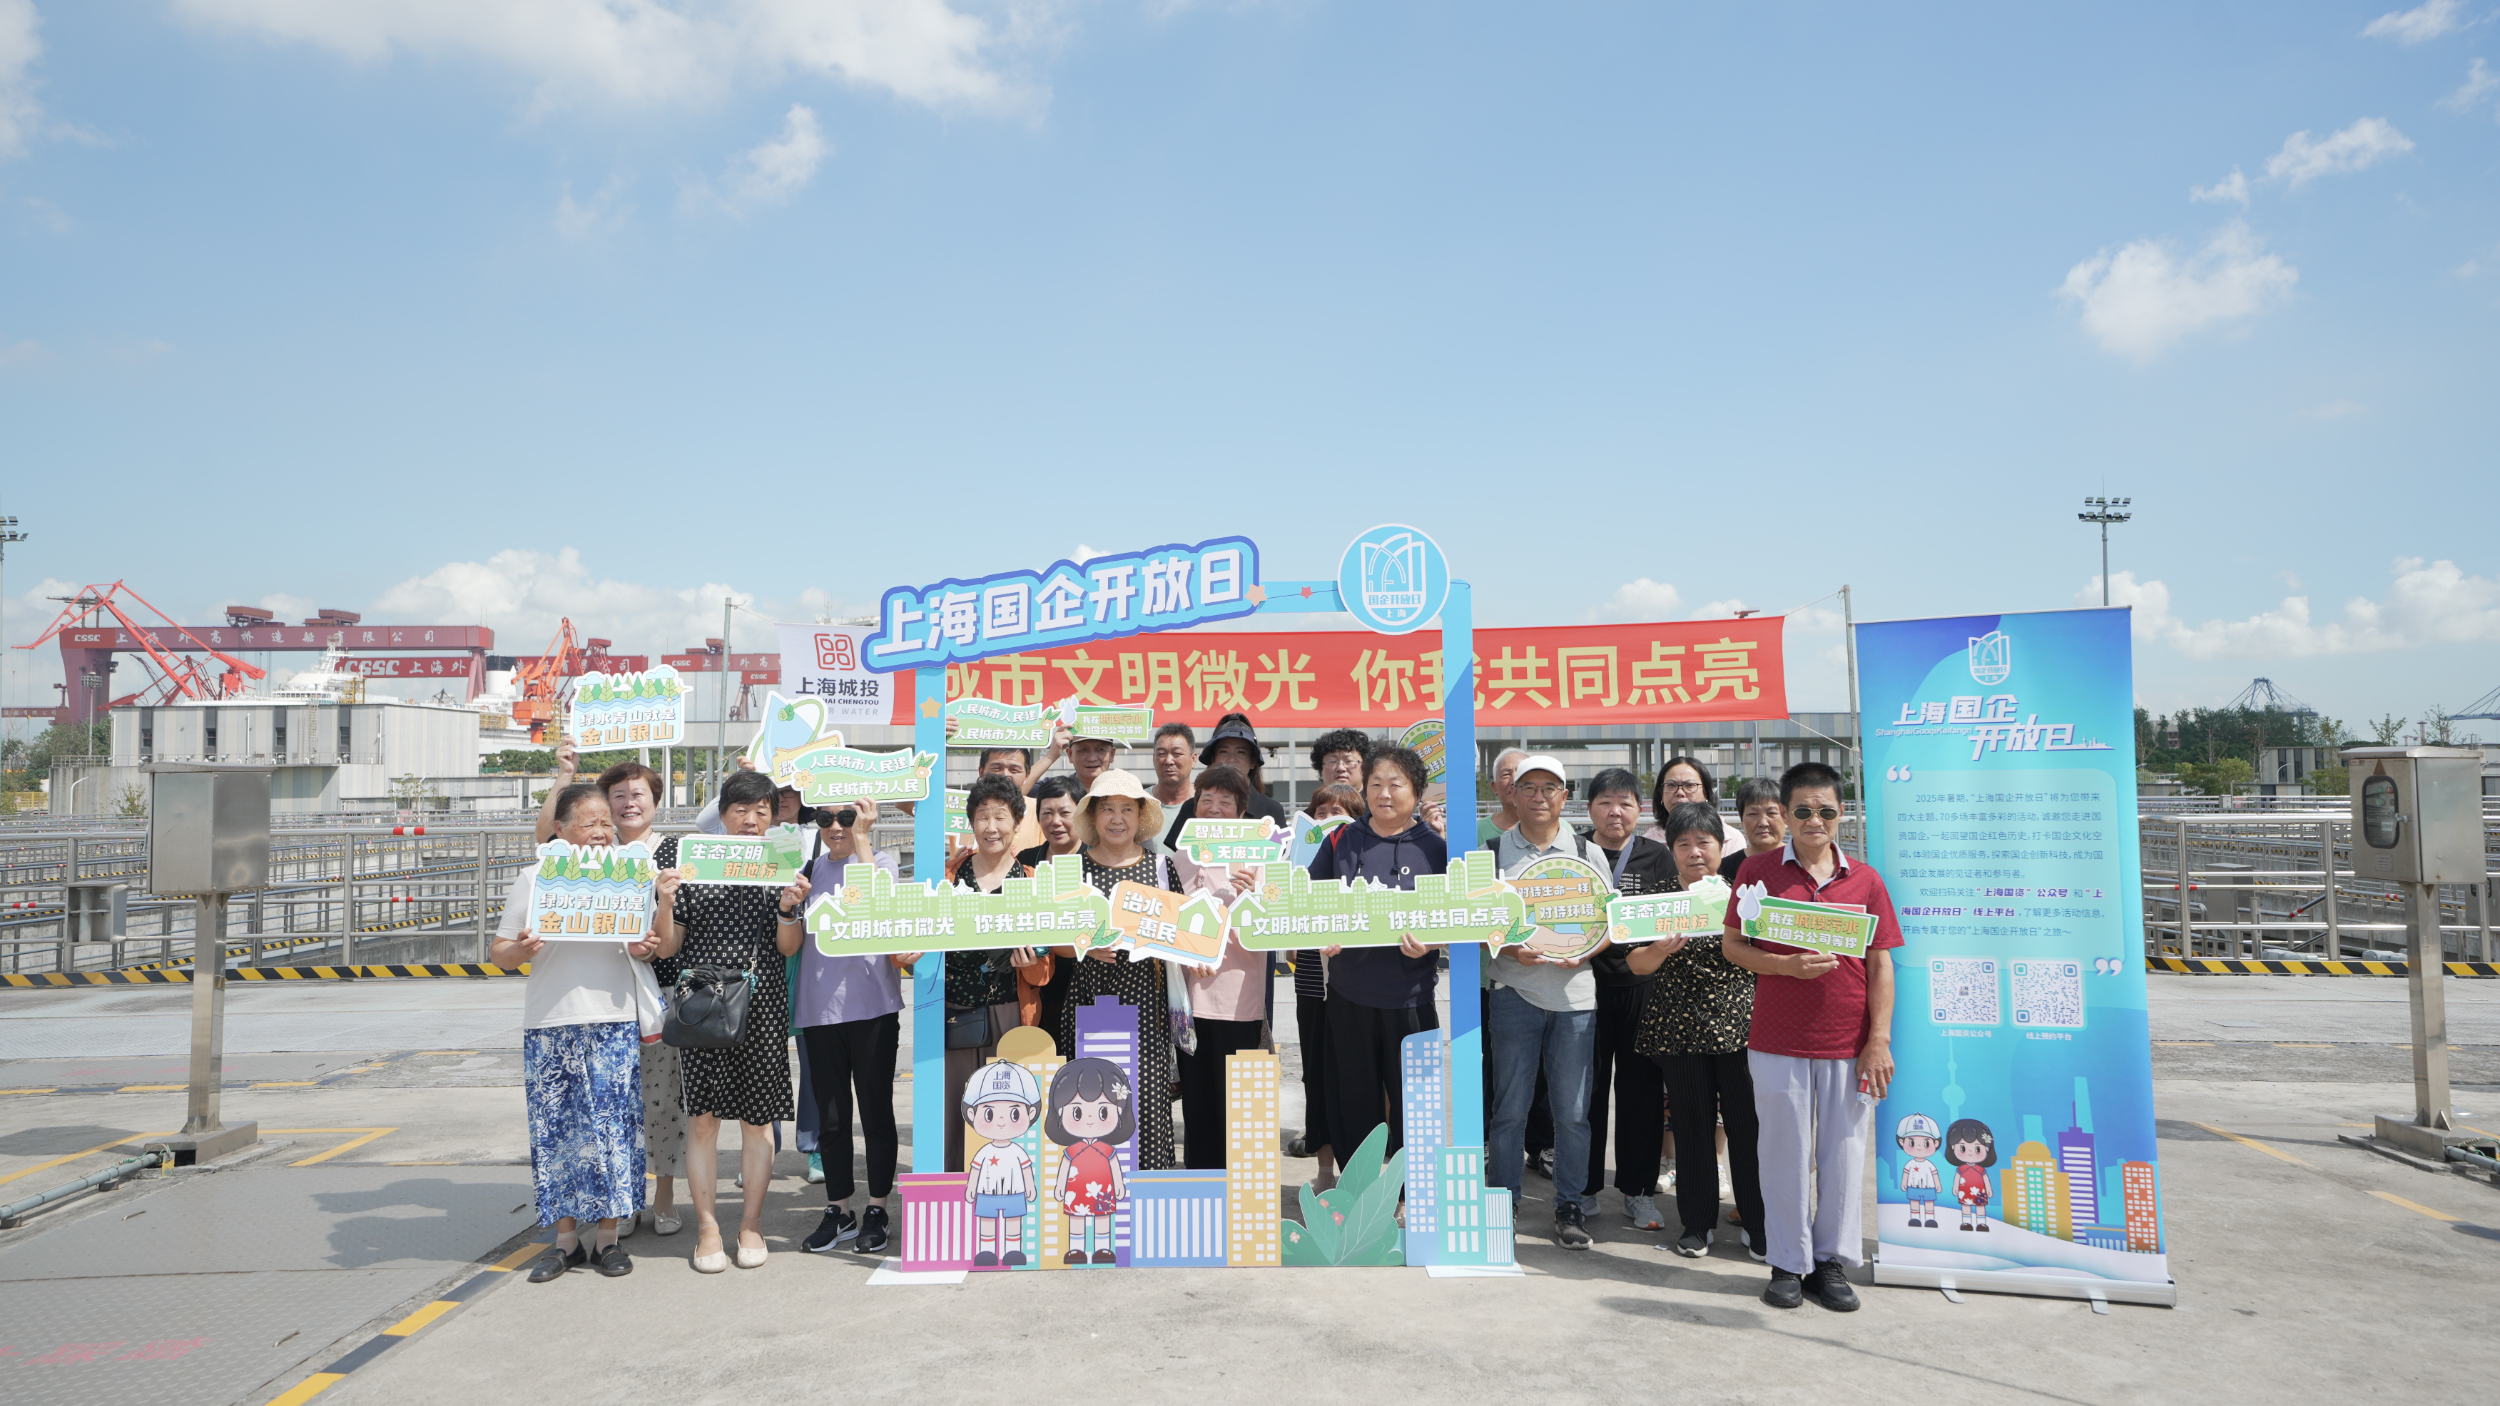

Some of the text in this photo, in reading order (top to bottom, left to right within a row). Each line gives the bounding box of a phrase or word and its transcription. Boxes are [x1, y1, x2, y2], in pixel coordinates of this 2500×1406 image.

[872, 548, 1245, 654] 上海国企开放日
[1369, 594, 1421, 605] 国企开放日
[74, 634, 101, 642] CSSC
[344, 660, 400, 676] CSSC
[795, 677, 879, 697] 上海城投
[579, 707, 676, 727] 绿水青山就是
[842, 708, 878, 716] WATER
[955, 702, 1037, 724] 人民城市人民建
[1892, 694, 2019, 726] 上海国企
[580, 722, 675, 746] 金山银山
[953, 727, 1043, 742] 人民城市为人民
[1968, 713, 2075, 761] 开放日
[810, 753, 909, 774] 人民城市人民建
[813, 778, 919, 799] 人民城市为人民
[1194, 824, 1254, 840] 智慧工厂
[689, 842, 764, 861] 生态文明
[1217, 845, 1278, 861] 无废工厂
[721, 860, 778, 880] 新地标
[1515, 882, 1590, 899] 对待生命一样
[539, 892, 645, 912] 绿水青山就是
[1122, 889, 1163, 917] 治水
[1539, 903, 1596, 920] 对待环境
[1619, 899, 1691, 921] 生态文明
[537, 911, 642, 935] 金山银山
[830, 909, 1097, 941] 文明城市微光 你我共同点亮
[1136, 916, 1178, 944] 惠民
[1252, 906, 1511, 937] 文明城市微光 你我共同点亮
[1655, 914, 1709, 934] 新地标
[1768, 911, 1860, 935] 我在城投污水
[1767, 927, 1859, 949] 竹园分公司等你
[993, 1071, 1011, 1080] 上海
